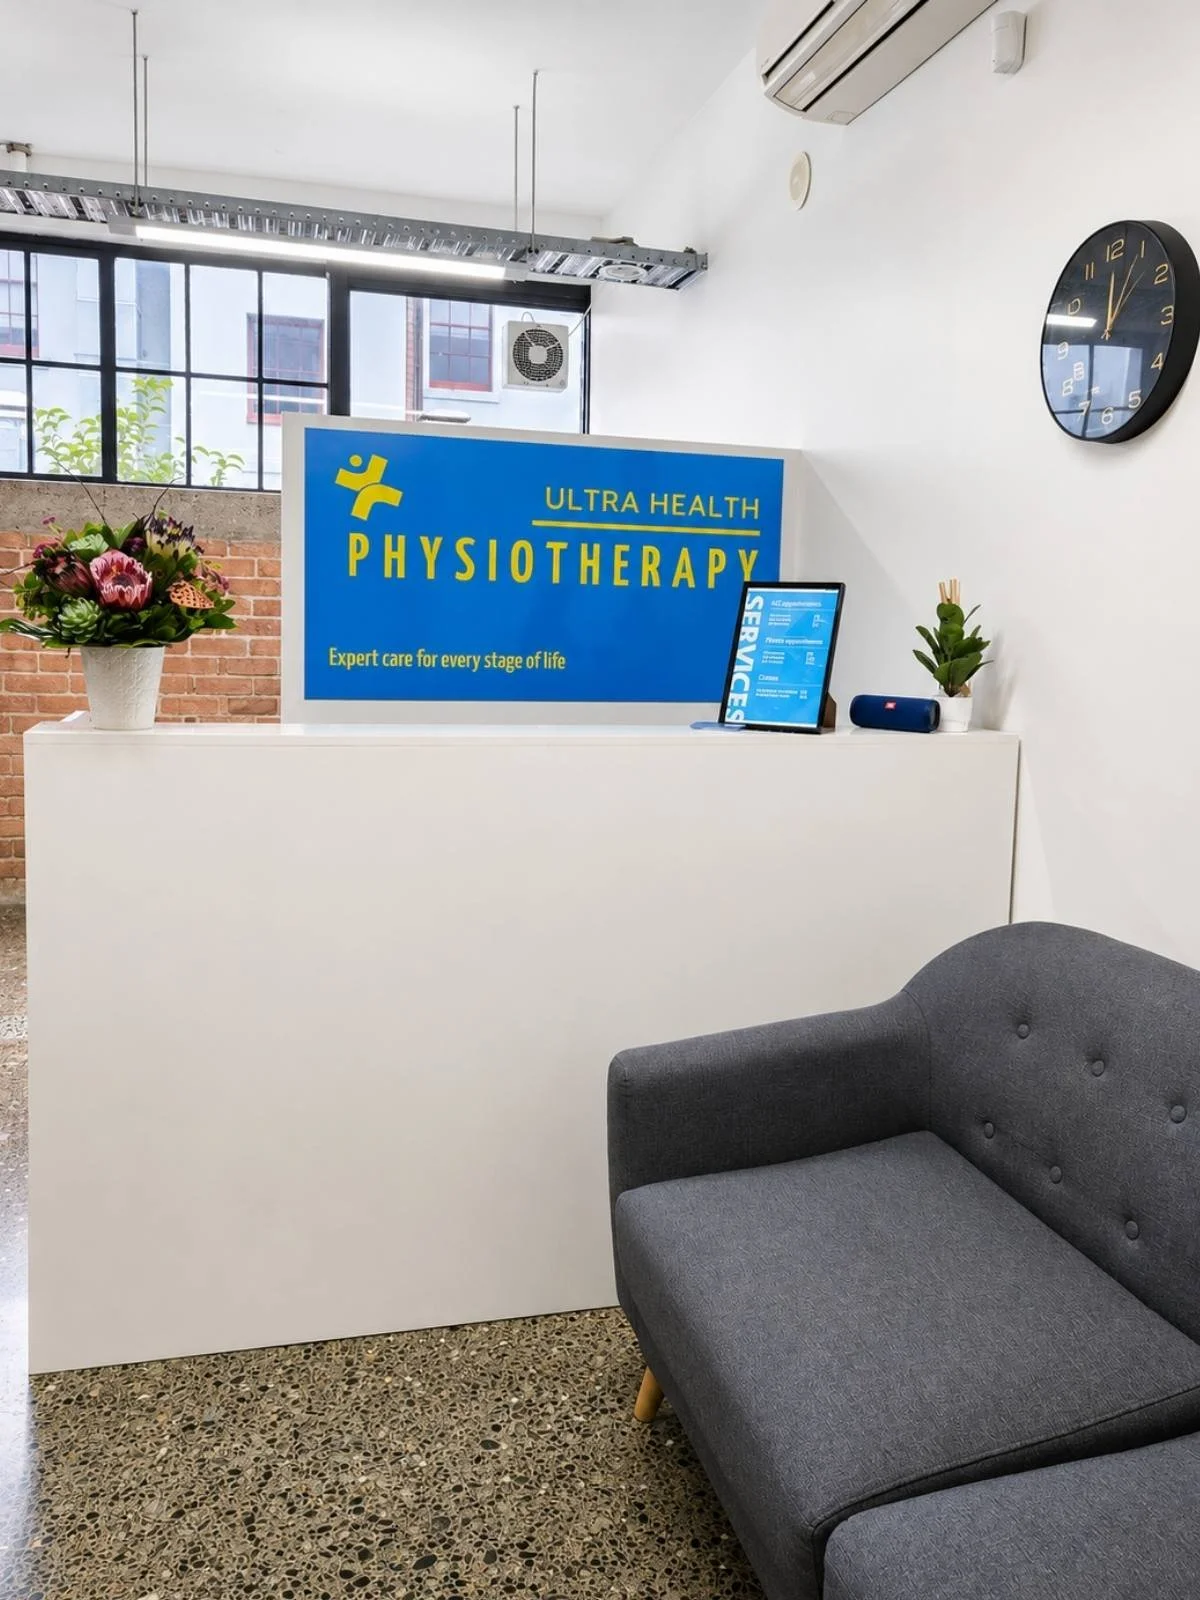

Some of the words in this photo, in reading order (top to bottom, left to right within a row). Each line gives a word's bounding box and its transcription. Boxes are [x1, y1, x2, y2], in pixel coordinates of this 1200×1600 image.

[1106, 238, 1125, 263] 12
[1084, 261, 1095, 281] 11
[1153, 263, 1169, 285] 2
[1160, 305, 1174, 326] 3
[1151, 352, 1165, 370] 4
[1128, 389, 1142, 409] 5
[1101, 406, 1115, 425] 6
[545, 487, 640, 514] ULTRA
[650, 493, 760, 520] HEALTH
[348, 532, 759, 589] PHYSIOTHERAPY
[329, 647, 379, 671] Expert
[382, 652, 413, 667] care
[416, 648, 438, 668] for
[441, 653, 480, 673] every
[484, 651, 523, 674] stage
[526, 650, 542, 670] of
[543, 650, 566, 670] life
[725, 593, 764, 721] SERVICES
